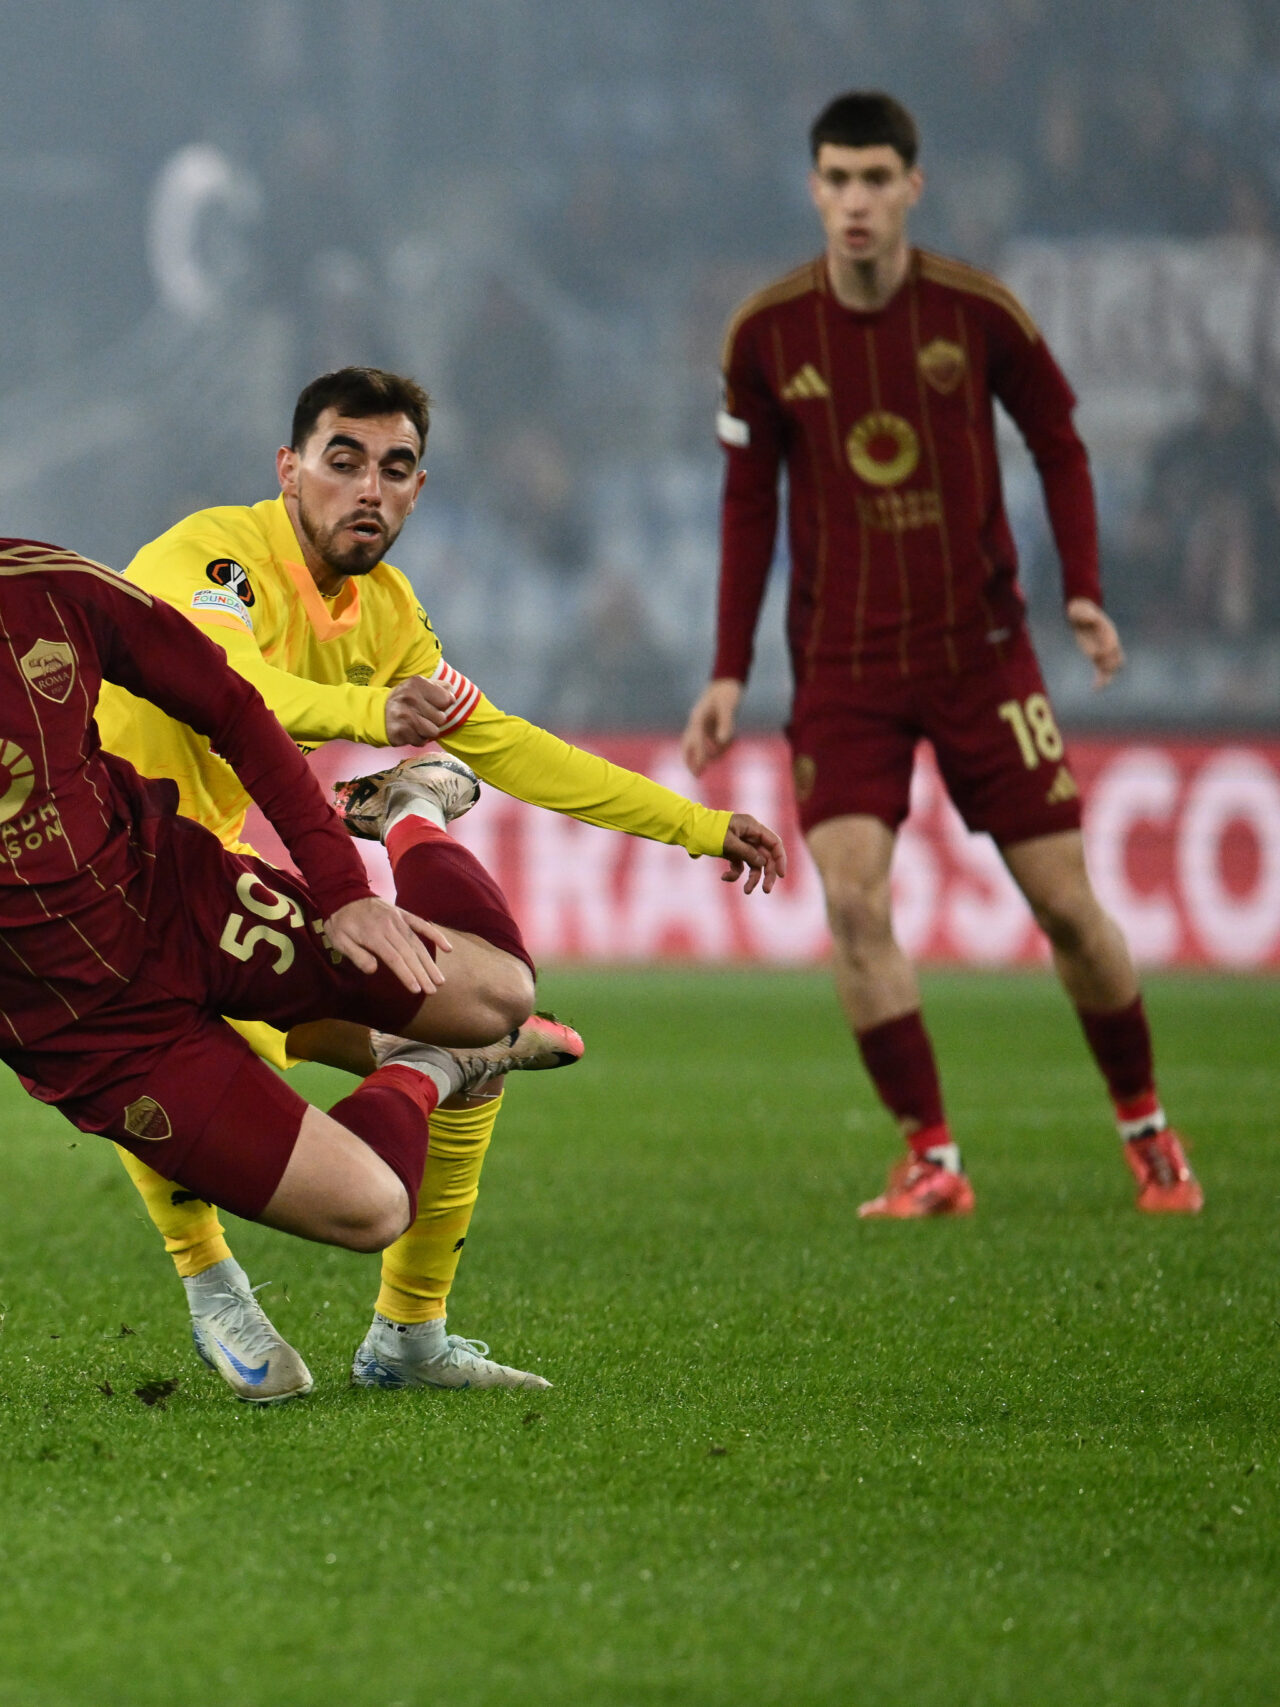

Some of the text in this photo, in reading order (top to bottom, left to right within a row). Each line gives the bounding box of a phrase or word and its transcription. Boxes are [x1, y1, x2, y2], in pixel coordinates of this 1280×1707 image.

[38, 671, 70, 689] ROMA
[998, 692, 1063, 770] 18
[219, 872, 304, 975] 59
